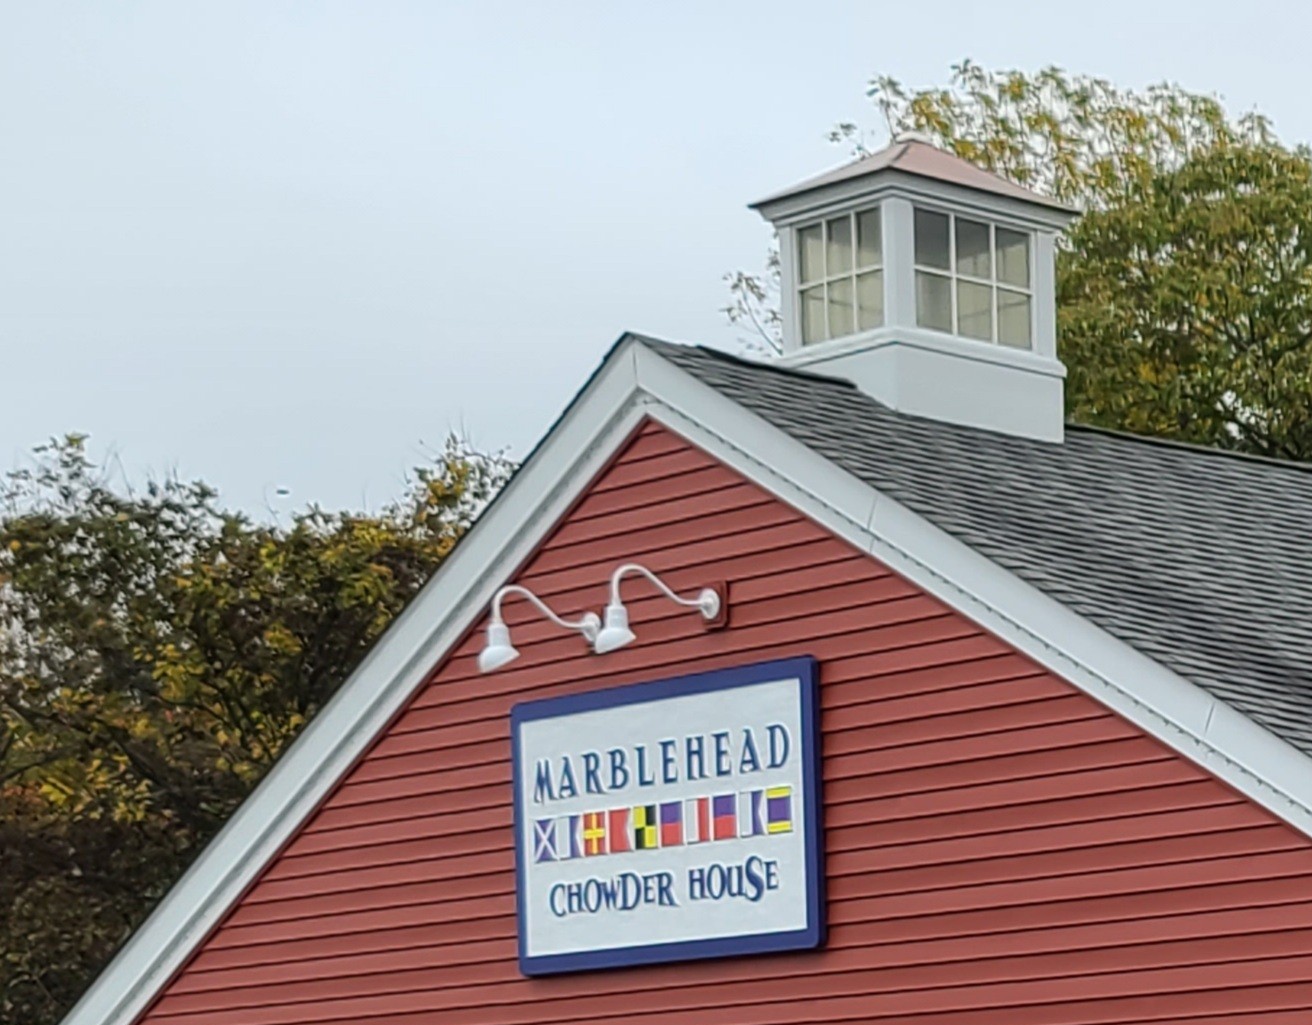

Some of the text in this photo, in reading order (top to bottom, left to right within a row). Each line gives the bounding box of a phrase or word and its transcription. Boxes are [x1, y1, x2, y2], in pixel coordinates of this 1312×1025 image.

[533, 723, 790, 804] MARBLEHEAD
[549, 855, 780, 918] CHOWDER HOUSE
